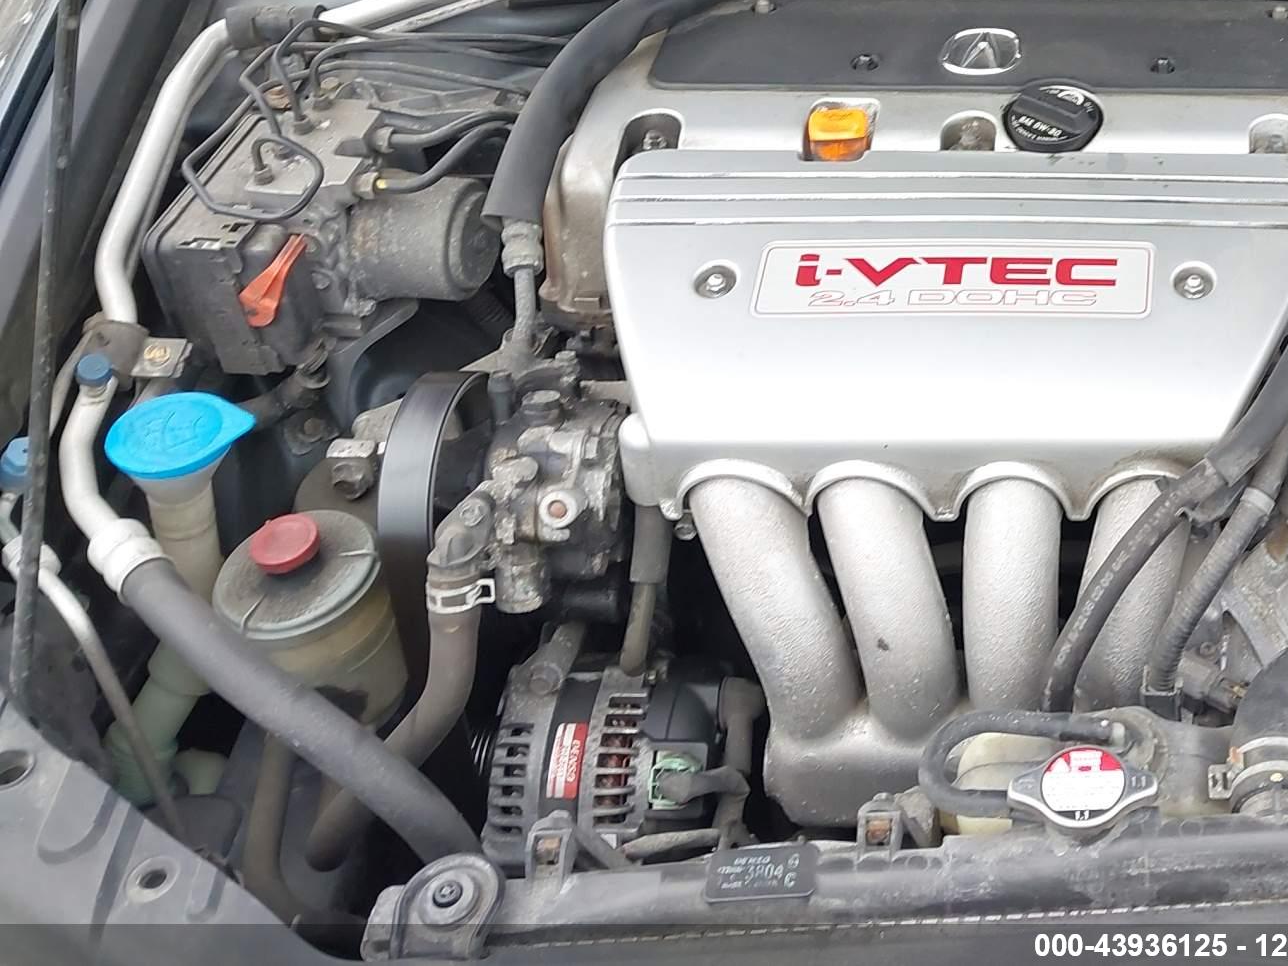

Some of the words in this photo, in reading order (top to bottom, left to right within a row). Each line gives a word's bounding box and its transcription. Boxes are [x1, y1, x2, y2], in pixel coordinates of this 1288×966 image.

[795, 253, 1118, 287] i-VTEC
[808, 289, 895, 307] 2.4
[906, 289, 1098, 307] DOHC
